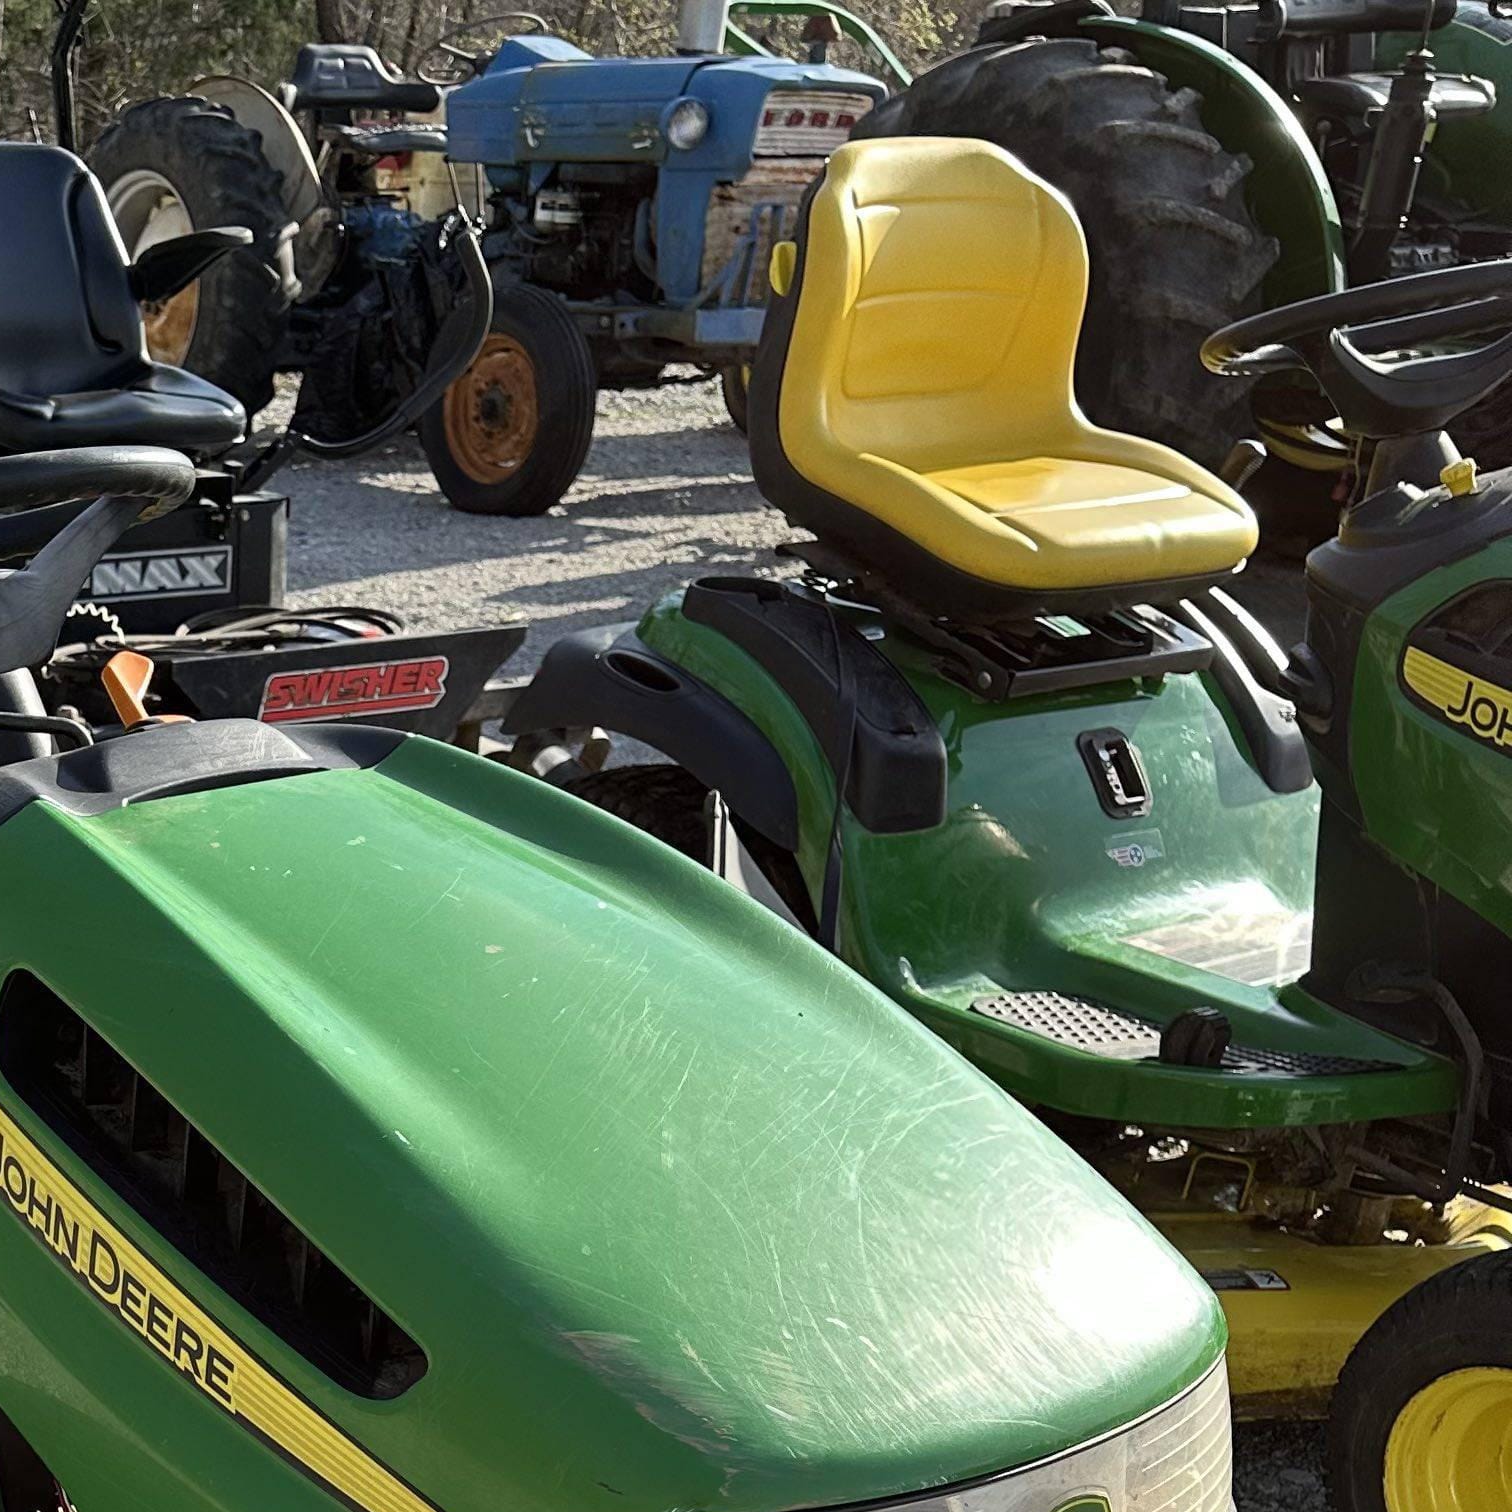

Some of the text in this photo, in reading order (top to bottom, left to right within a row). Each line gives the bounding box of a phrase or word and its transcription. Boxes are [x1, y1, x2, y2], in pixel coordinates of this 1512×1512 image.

[763, 108, 855, 128] FORD
[265, 662, 445, 708] SWISHER
[89, 1228, 235, 1404] DEERE
